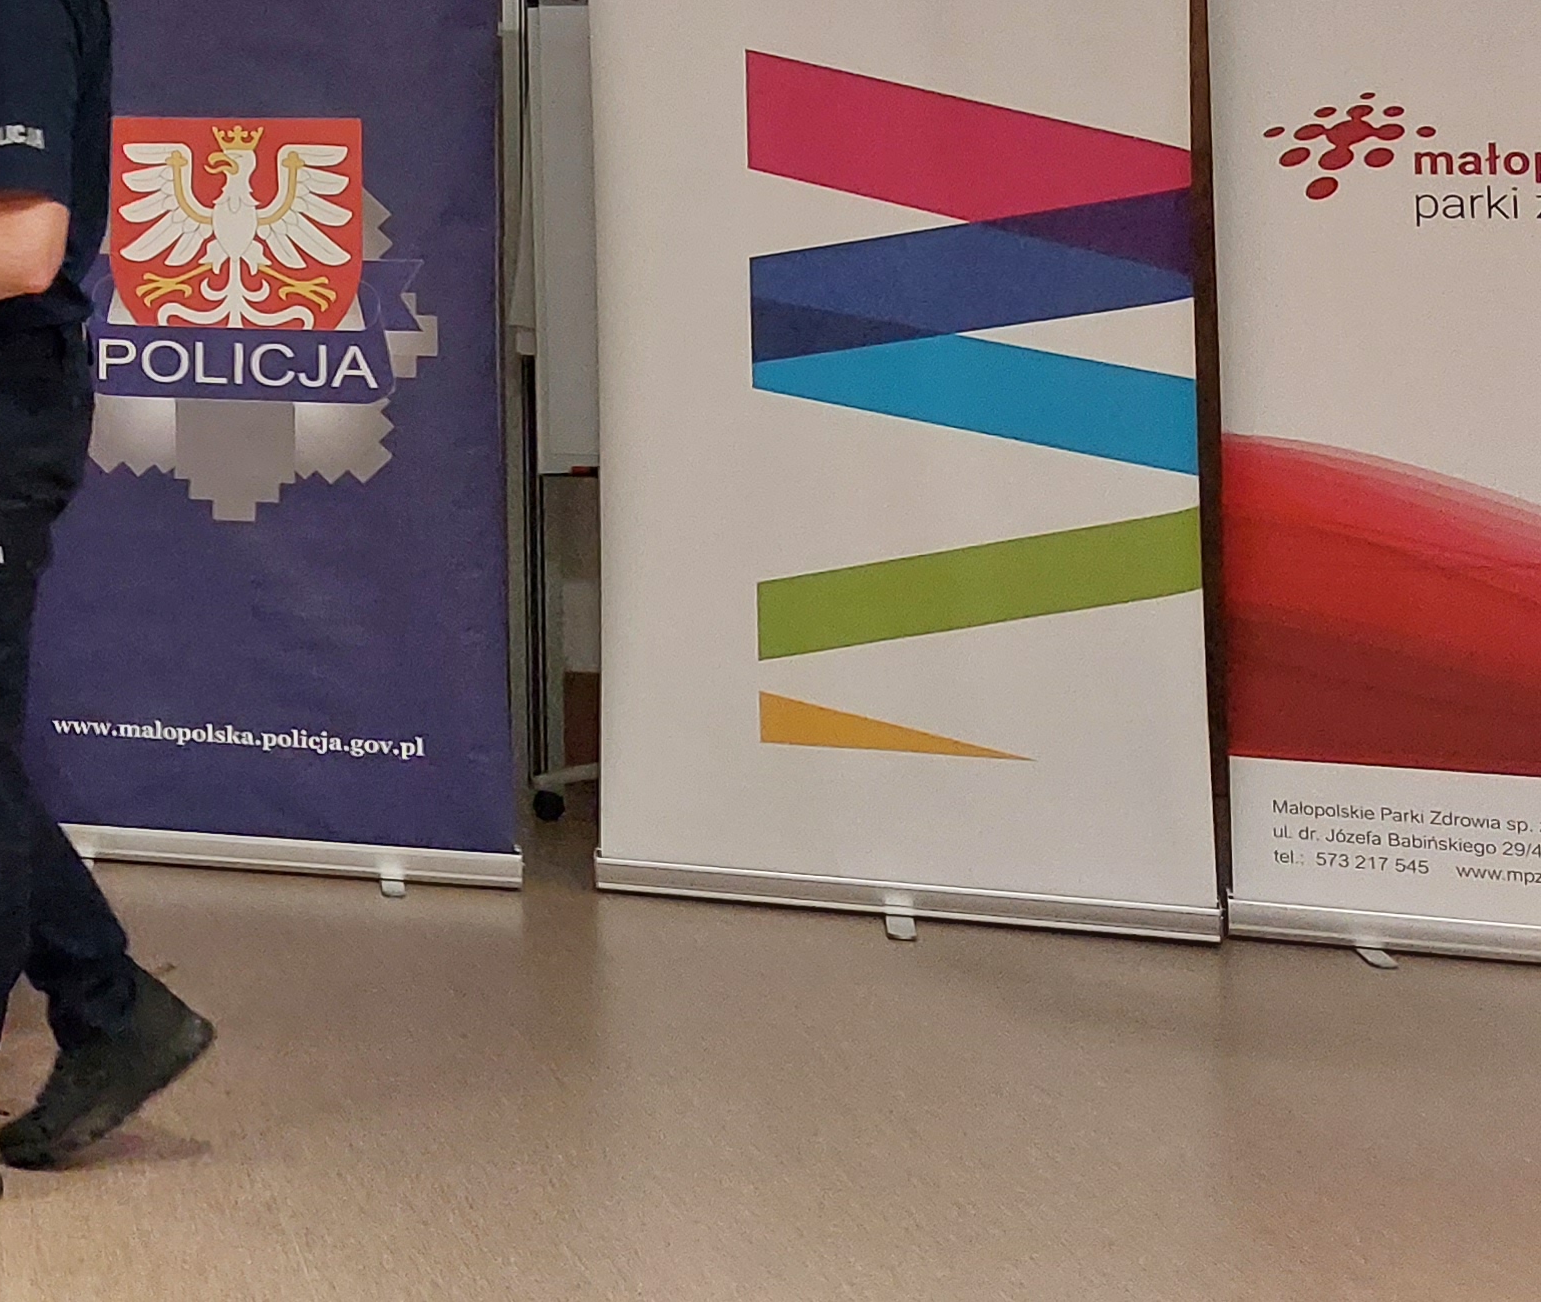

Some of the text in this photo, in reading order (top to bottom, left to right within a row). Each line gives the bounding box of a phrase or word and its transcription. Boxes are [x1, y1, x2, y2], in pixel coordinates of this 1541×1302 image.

[1414, 142, 1541, 184] mało
[1415, 185, 1519, 227] parki
[97, 338, 379, 389] POLICJA
[52, 717, 425, 760] www.malopolska.policja.gov.pl
[1298, 826, 1320, 841] dr.
[1325, 828, 1381, 846] Józefa
[1388, 832, 1497, 857] Babińskiego
[1380, 806, 1425, 824] Parki
[1429, 810, 1501, 830] Zdrowia
[1506, 819, 1534, 835] sp.
[1316, 851, 1350, 868] 573
[1354, 854, 1389, 871] 217
[1394, 858, 1430, 875] 545
